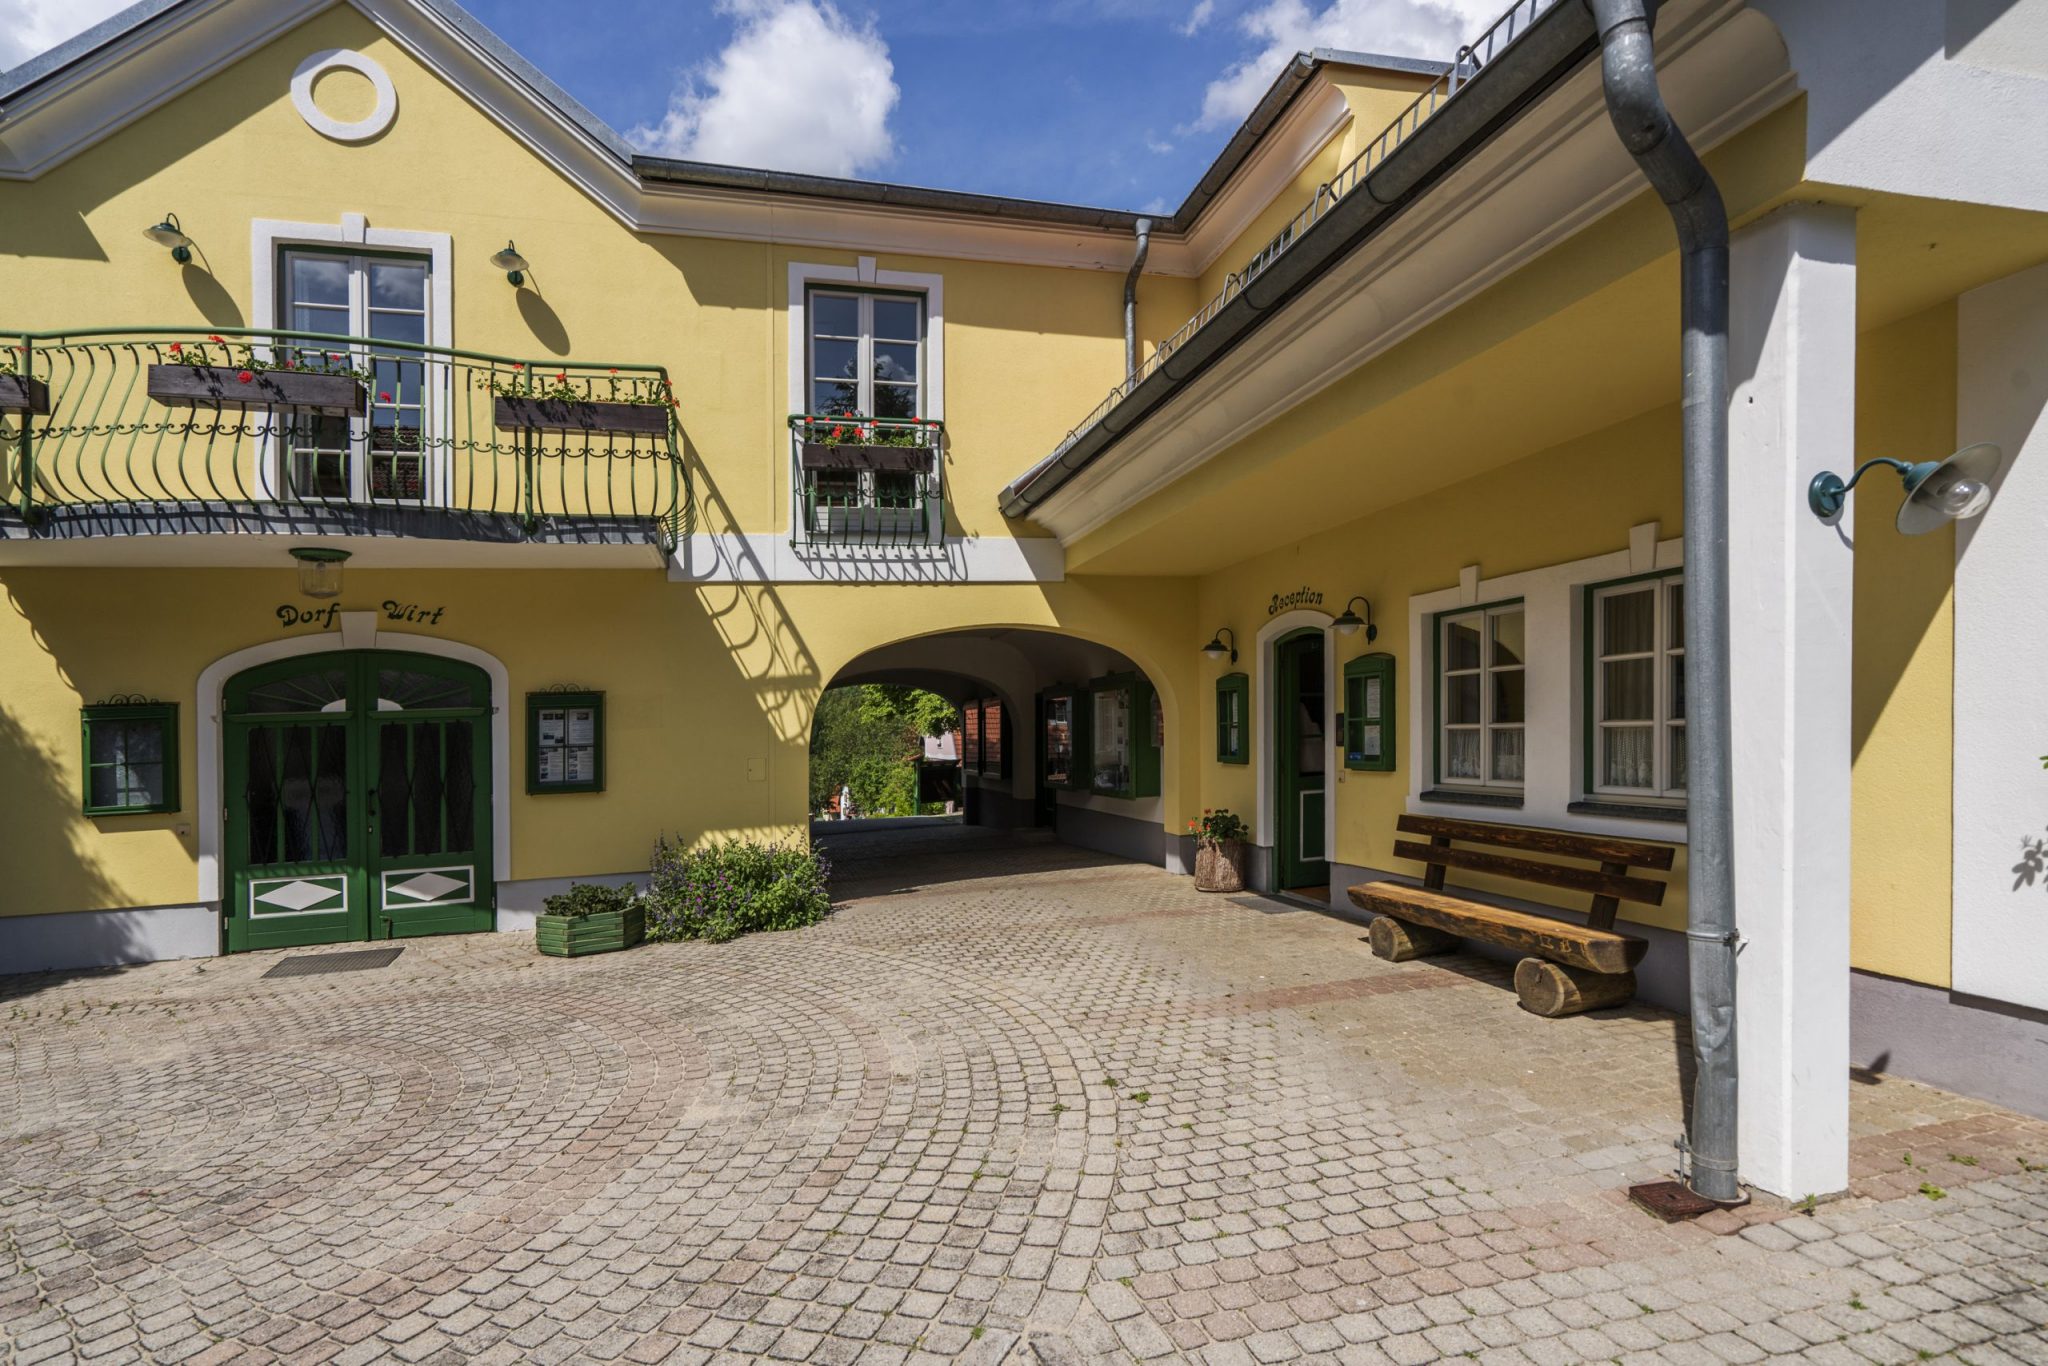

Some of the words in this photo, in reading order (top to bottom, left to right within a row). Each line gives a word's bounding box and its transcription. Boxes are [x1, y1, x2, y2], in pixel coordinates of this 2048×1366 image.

[276, 603, 340, 629] Dorf
[382, 600, 446, 625] Wirt
[1268, 586, 1323, 615] Reception
